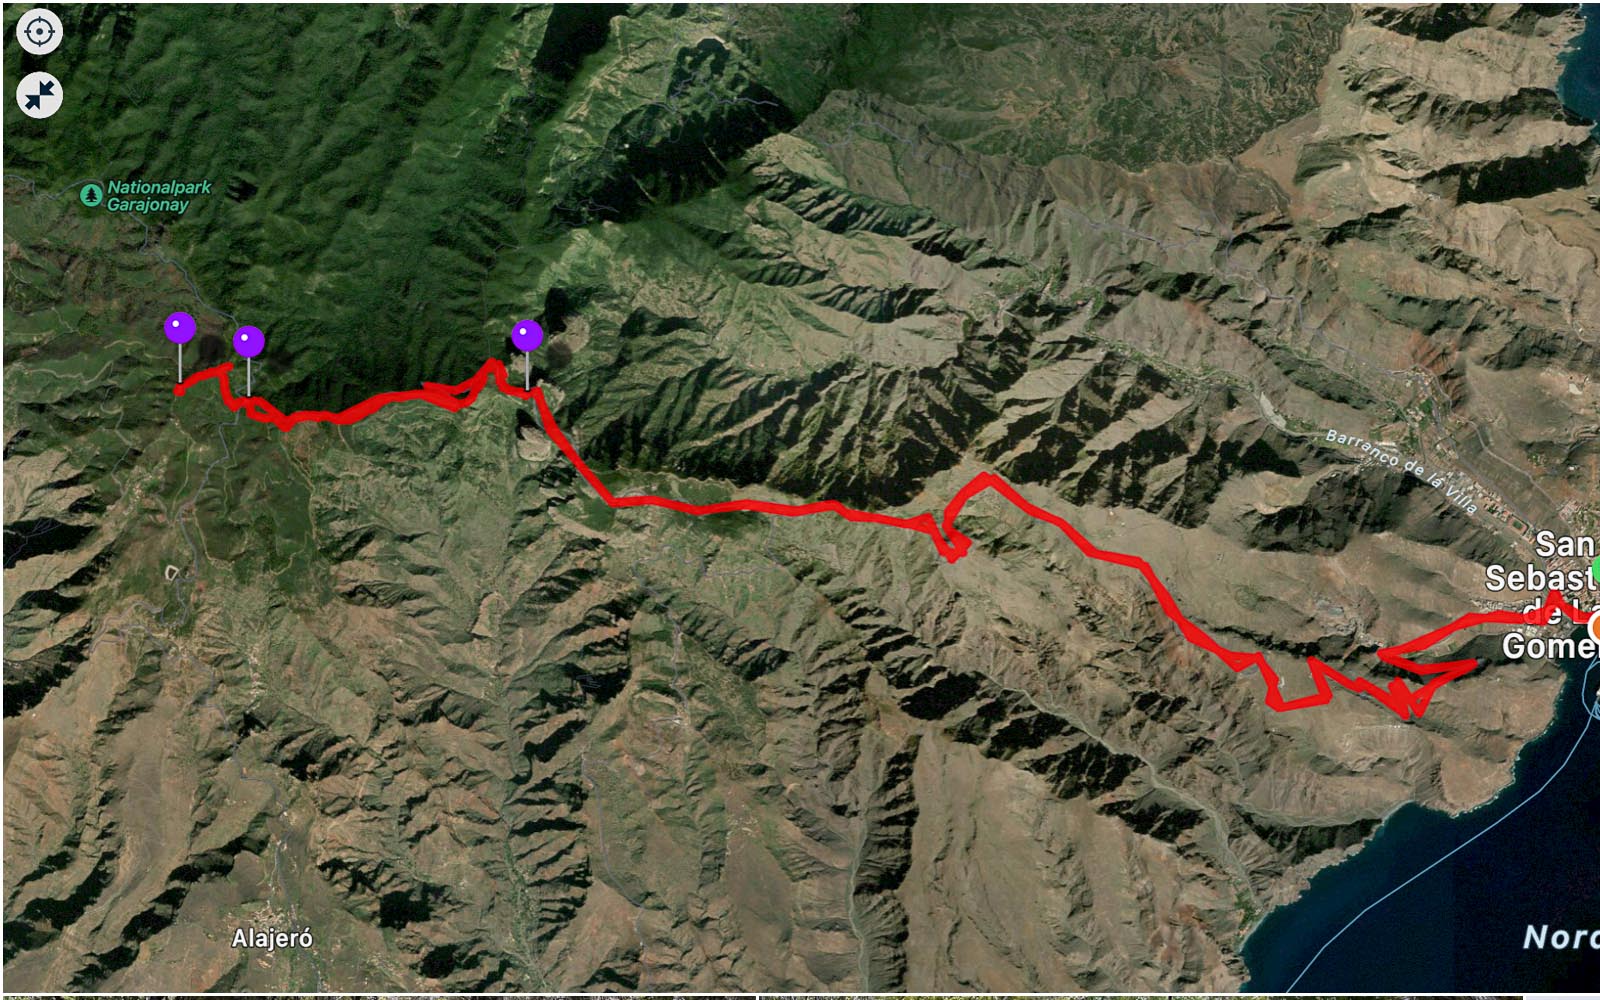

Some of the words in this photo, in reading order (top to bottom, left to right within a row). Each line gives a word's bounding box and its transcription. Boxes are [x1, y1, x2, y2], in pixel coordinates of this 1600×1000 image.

[107, 180, 212, 196] Nationalpark
[107, 197, 189, 214] Garajonay
[1325, 429, 1399, 466] Barranco
[1404, 460, 1424, 476] de
[1427, 472, 1442, 488] la
[1446, 485, 1477, 514] Villa
[1536, 530, 1594, 557] San
[1522, 598, 1562, 625] de
[231, 927, 313, 952] Alajeró
